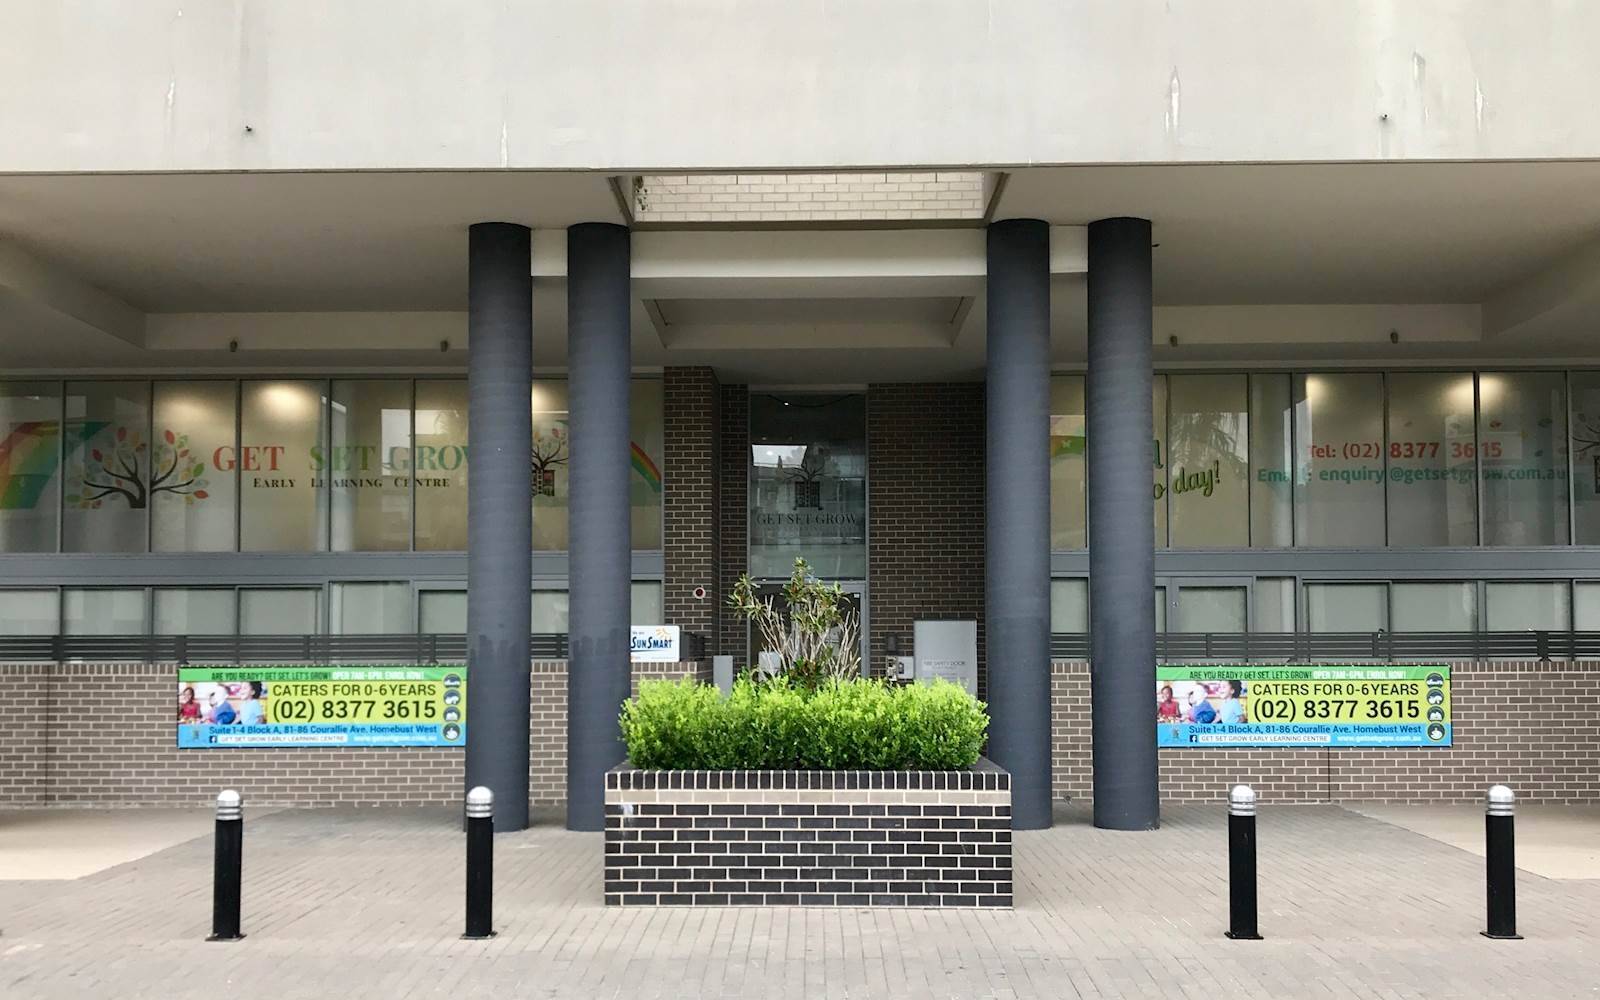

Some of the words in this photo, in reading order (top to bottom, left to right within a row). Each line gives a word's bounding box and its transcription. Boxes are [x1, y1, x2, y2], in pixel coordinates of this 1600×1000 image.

[1343, 442, 1380, 459] (02)
[1390, 442, 1440, 458] 8377
[1451, 442, 1502, 458] 3615
[212, 446, 285, 471] GET
[309, 446, 377, 471] SET
[253, 478, 296, 488] EARLY
[756, 513, 783, 525] GET
[815, 513, 857, 525] GROW
[211, 672, 223, 680] ARE
[225, 672, 238, 680] YOU
[1189, 671, 1201, 680] ARE
[1204, 671, 1217, 680] YOU
[1244, 671, 1256, 680] GET
[273, 684, 328, 697] CATERS
[332, 684, 361, 697] FOR
[364, 684, 388, 697] 0-6
[389, 684, 437, 697] YEARS
[1252, 684, 1309, 696] CATERS
[1314, 684, 1342, 696] FOR
[1346, 684, 1369, 696] 0-6
[1371, 684, 1419, 696] YEARS
[273, 700, 316, 723] (02)
[322, 701, 377, 719] 8377
[383, 701, 437, 719] 3615
[1254, 699, 1297, 722] (02)
[1303, 700, 1359, 719] 8377
[1365, 700, 1420, 719] 3615
[209, 726, 231, 734] Suite
[232, 726, 246, 734] 1-4
[247, 726, 272, 734] Block
[284, 726, 308, 734] 81-86
[310, 726, 348, 734] Courallie
[416, 726, 438, 734] West
[1189, 725, 1211, 734] Suite
[1213, 725, 1226, 734] 1-4
[1228, 725, 1253, 734] Block
[1265, 725, 1291, 734] 81-86
[1292, 725, 1331, 734] Courallie
[1332, 725, 1352, 734] Ave.
[1400, 725, 1422, 734] West
